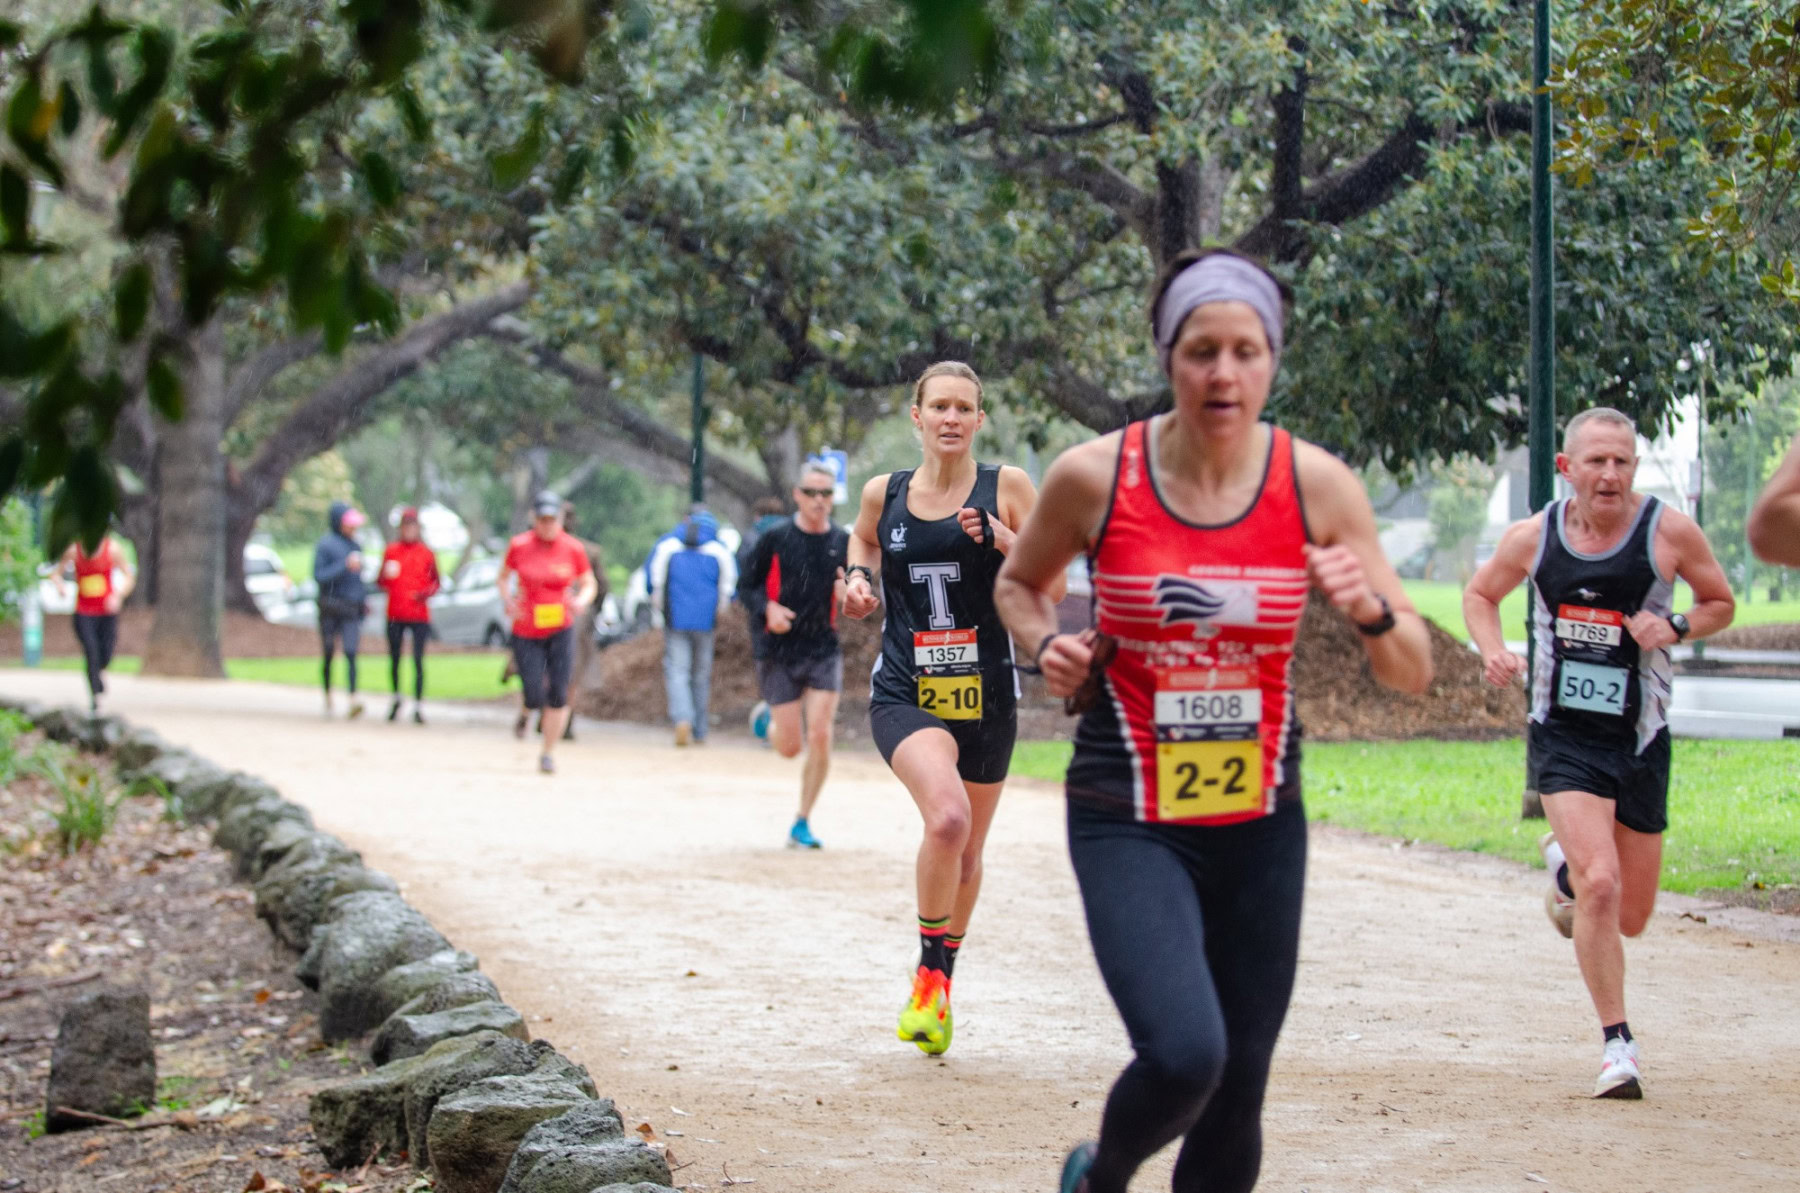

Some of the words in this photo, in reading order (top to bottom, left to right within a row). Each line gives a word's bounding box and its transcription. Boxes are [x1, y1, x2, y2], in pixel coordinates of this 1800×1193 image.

[1569, 623, 1609, 641] 1769
[927, 646, 967, 663] 1357
[921, 686, 979, 710] 2-10
[1564, 676, 1621, 704] 50-2
[1175, 694, 1243, 719] 1608
[1174, 756, 1247, 801] 2-2
